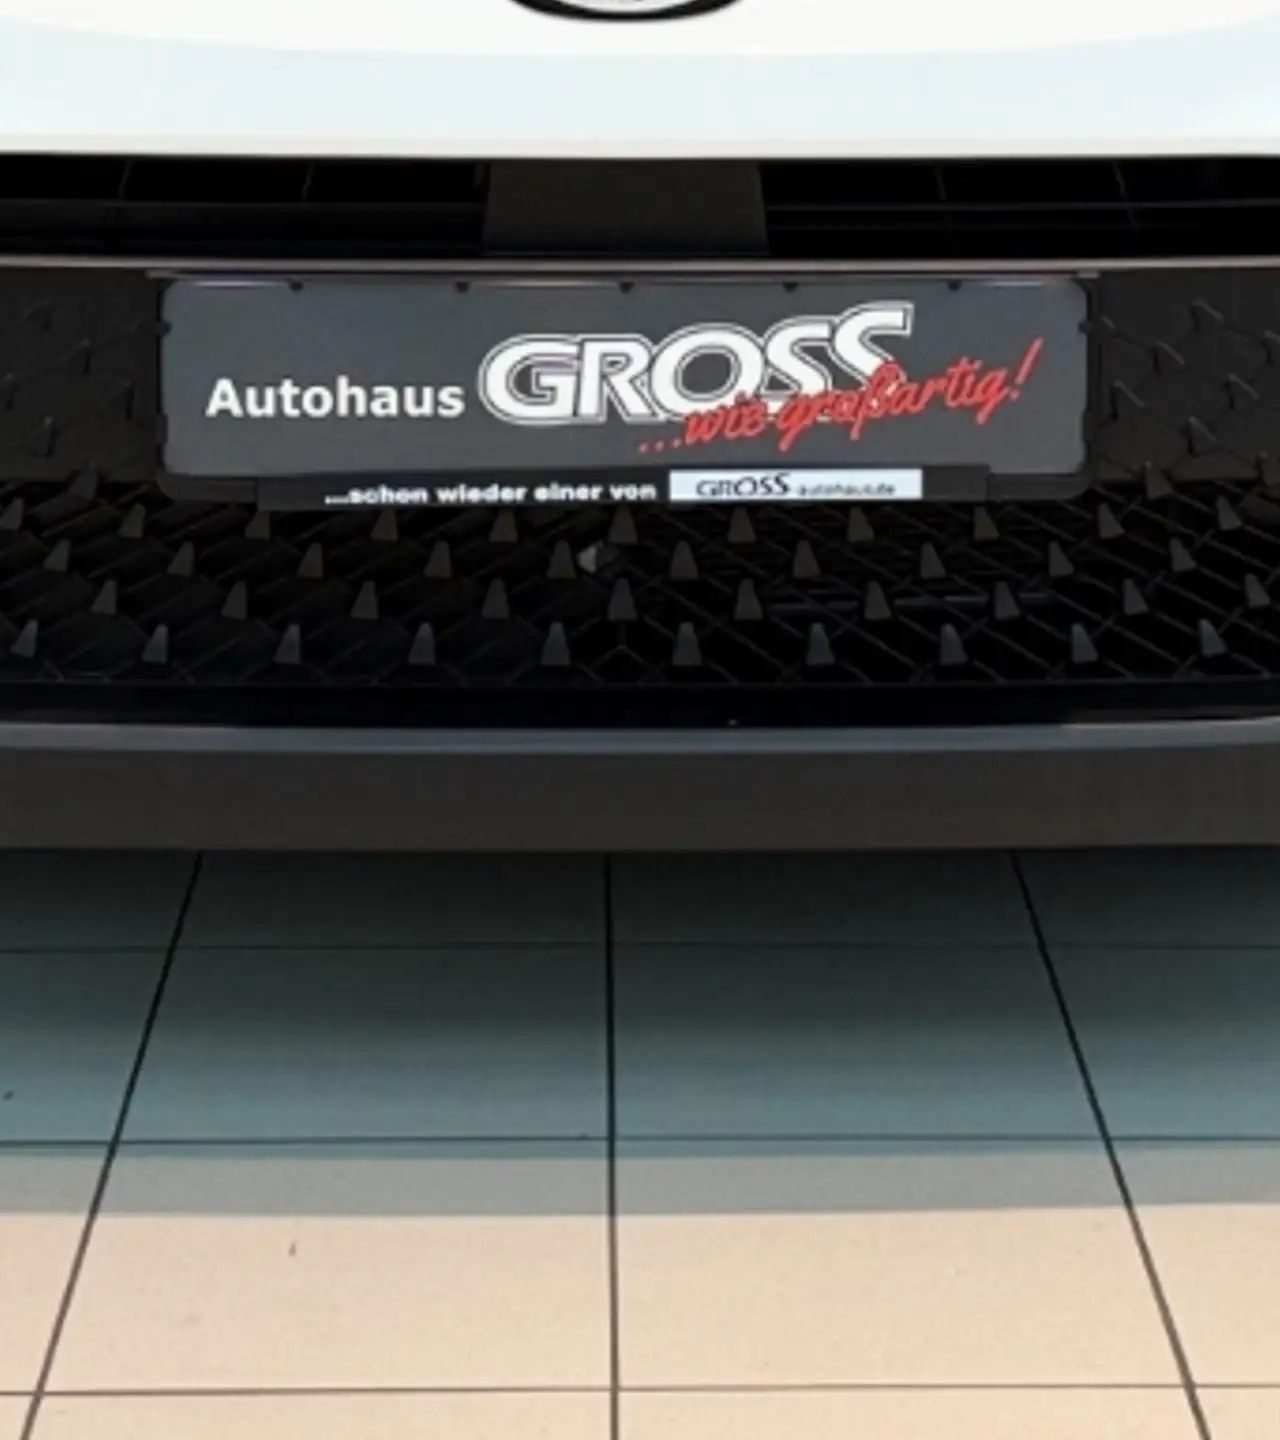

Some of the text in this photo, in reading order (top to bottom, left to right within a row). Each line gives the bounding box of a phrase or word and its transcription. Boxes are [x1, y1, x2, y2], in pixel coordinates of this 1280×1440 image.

[204, 301, 916, 427] Autohaus GROSS
[775, 336, 1045, 452] großartig!
[436, 483, 527, 503] wieder
[534, 481, 601, 502] einer
[609, 484, 656, 502] von
[696, 471, 792, 497] GROSS
